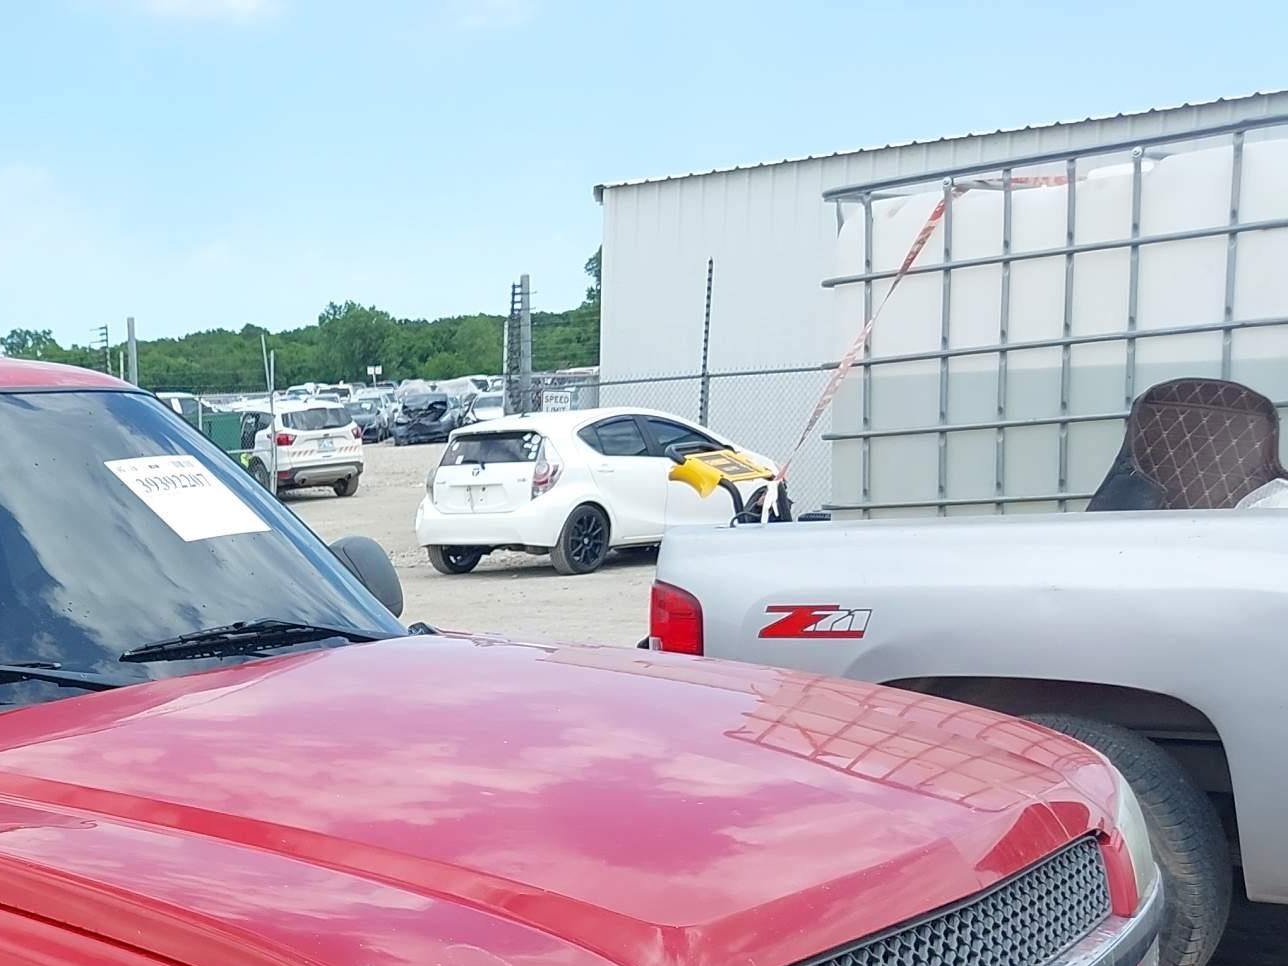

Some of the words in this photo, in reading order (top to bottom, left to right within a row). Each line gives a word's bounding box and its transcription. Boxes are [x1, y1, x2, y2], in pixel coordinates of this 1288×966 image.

[544, 395, 570, 404] SPEED
[135, 473, 212, 494] 39392207
[758, 604, 873, 639] Z71
